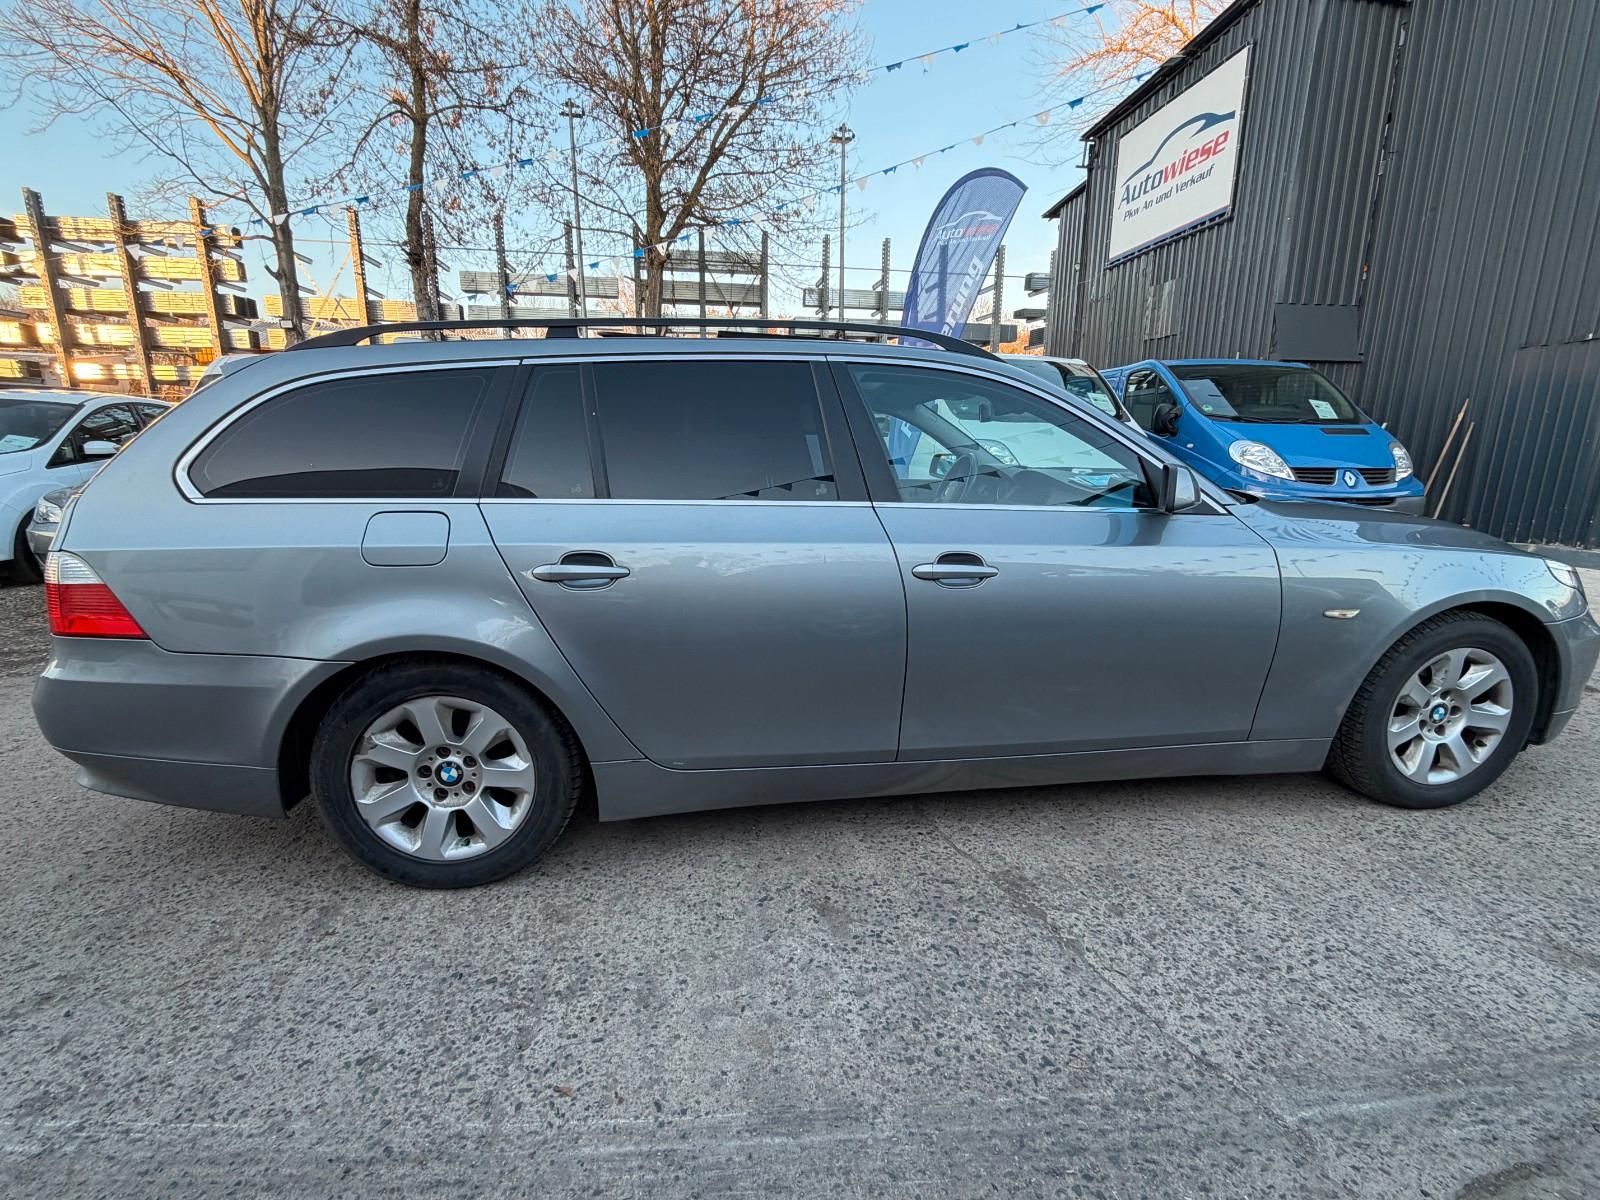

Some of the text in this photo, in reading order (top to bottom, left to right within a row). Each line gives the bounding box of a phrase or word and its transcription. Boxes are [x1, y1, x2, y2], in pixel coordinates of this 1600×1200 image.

[1118, 130, 1230, 210] Autowiese
[1123, 163, 1216, 223] Pkw An und Verkauf
